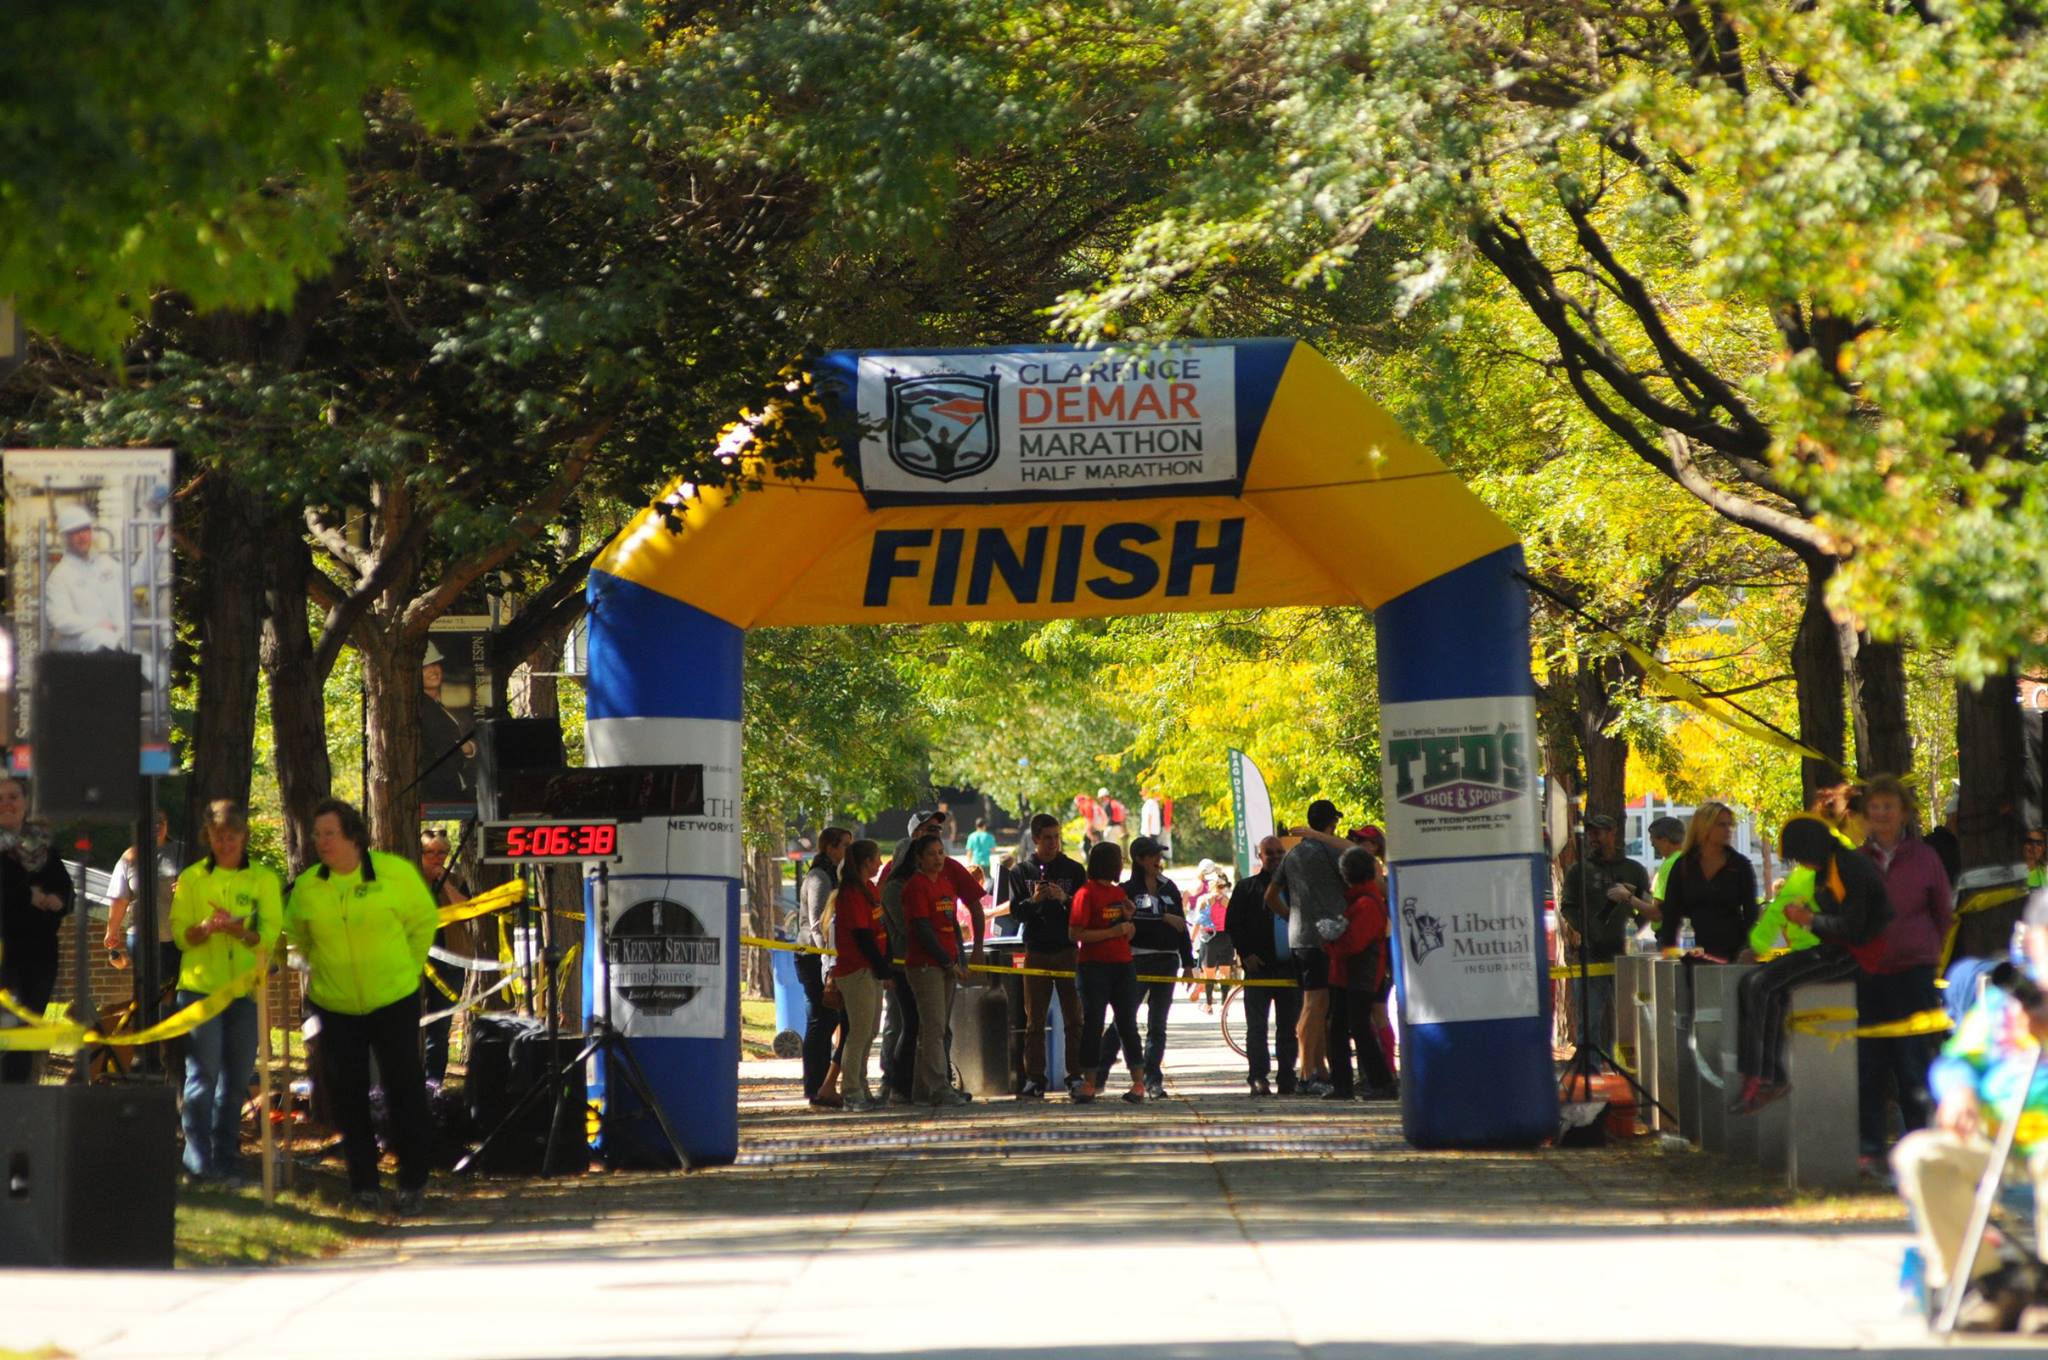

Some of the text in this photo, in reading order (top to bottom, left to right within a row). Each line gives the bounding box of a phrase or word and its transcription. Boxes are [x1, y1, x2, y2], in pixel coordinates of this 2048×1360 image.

[1017, 358, 1201, 385] CLARENCE
[1017, 383, 1201, 425] DEMAR
[1019, 428, 1203, 458] MARATHON
[1021, 459, 1203, 482] HALF MARATHON
[862, 517, 1246, 607] FINISH
[472, 636, 485, 661] ESPN
[15, 692, 31, 739] Senior
[1388, 721, 1527, 800] TED'S
[1424, 788, 1504, 808] SHOE & SPORT
[507, 824, 616, 856] 5:06:38
[667, 820, 734, 833] NETWORKS
[1452, 912, 1528, 934] Liberty
[665, 937, 719, 964] SENTINEL
[1453, 934, 1530, 957] Mutual
[1464, 961, 1533, 975] INSURANCE
